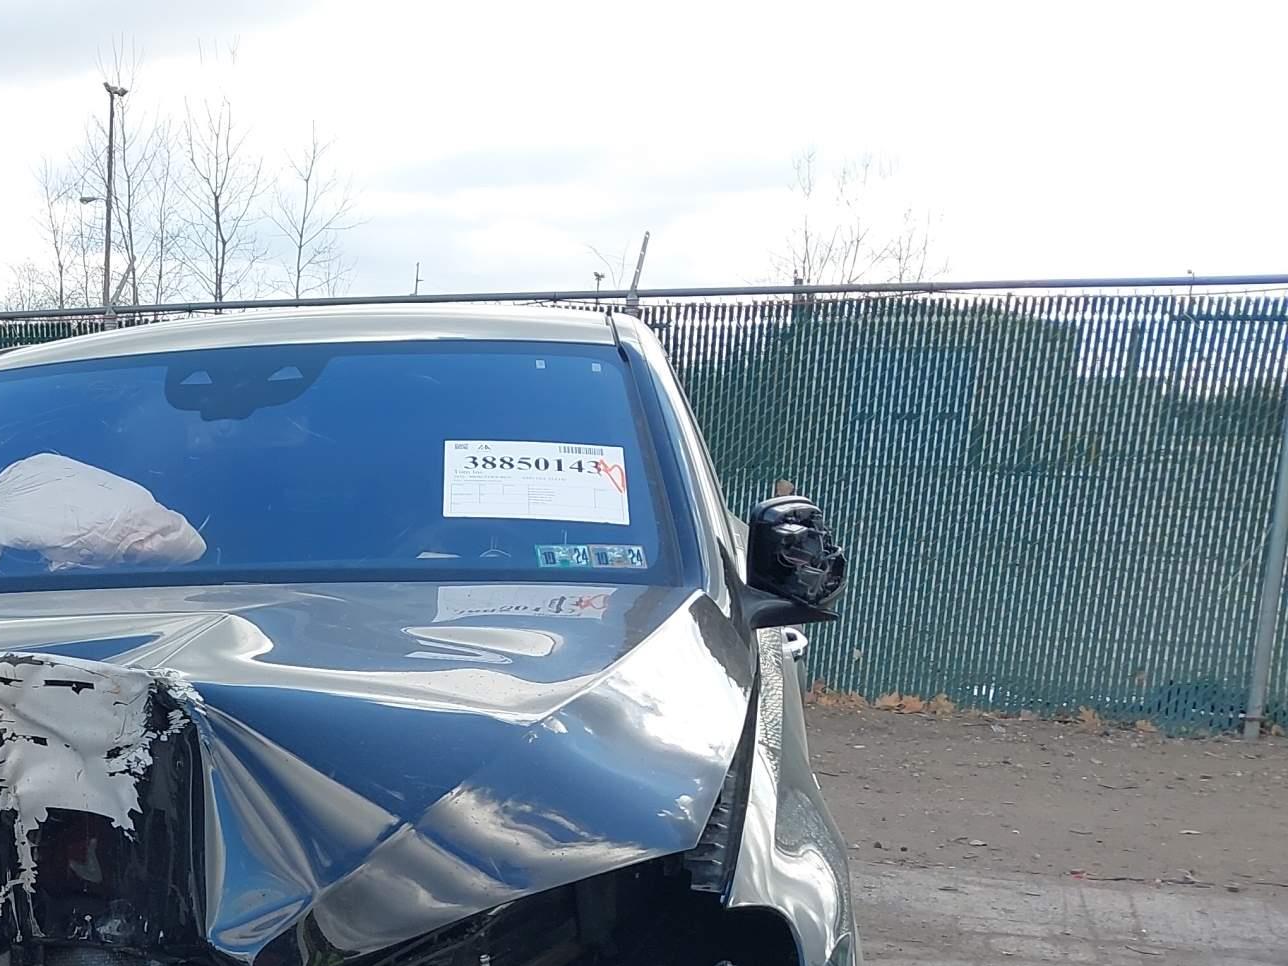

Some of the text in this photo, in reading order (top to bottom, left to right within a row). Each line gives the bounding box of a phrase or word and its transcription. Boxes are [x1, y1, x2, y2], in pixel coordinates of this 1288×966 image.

[464, 455, 602, 477] 38850143
[573, 547, 589, 564] 24
[627, 548, 643, 566] 24
